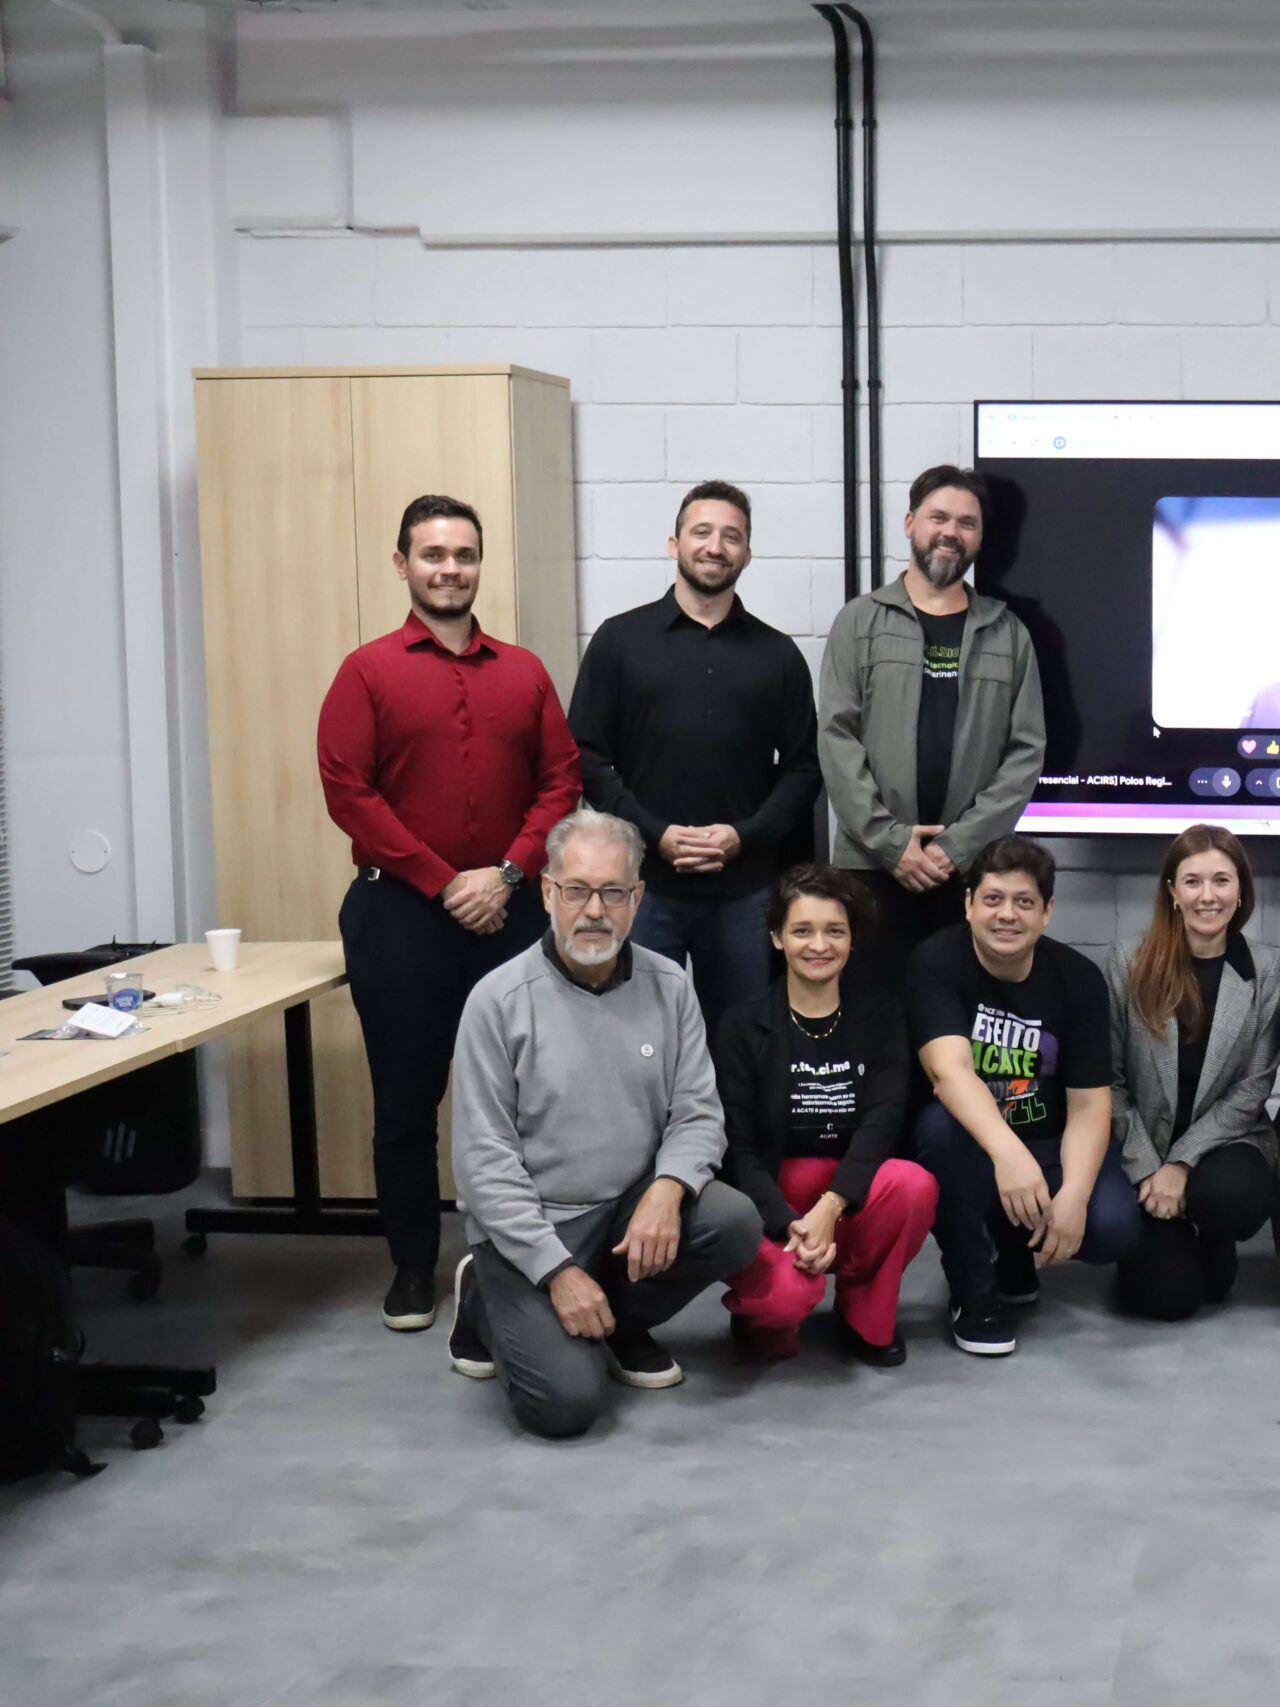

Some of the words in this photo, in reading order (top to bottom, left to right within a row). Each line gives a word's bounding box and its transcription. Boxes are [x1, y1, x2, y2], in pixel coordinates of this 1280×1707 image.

[1087, 775, 1118, 786] ACIRS]
[1119, 776, 1144, 786] Polos
[971, 1012, 1040, 1053] EFEITO
